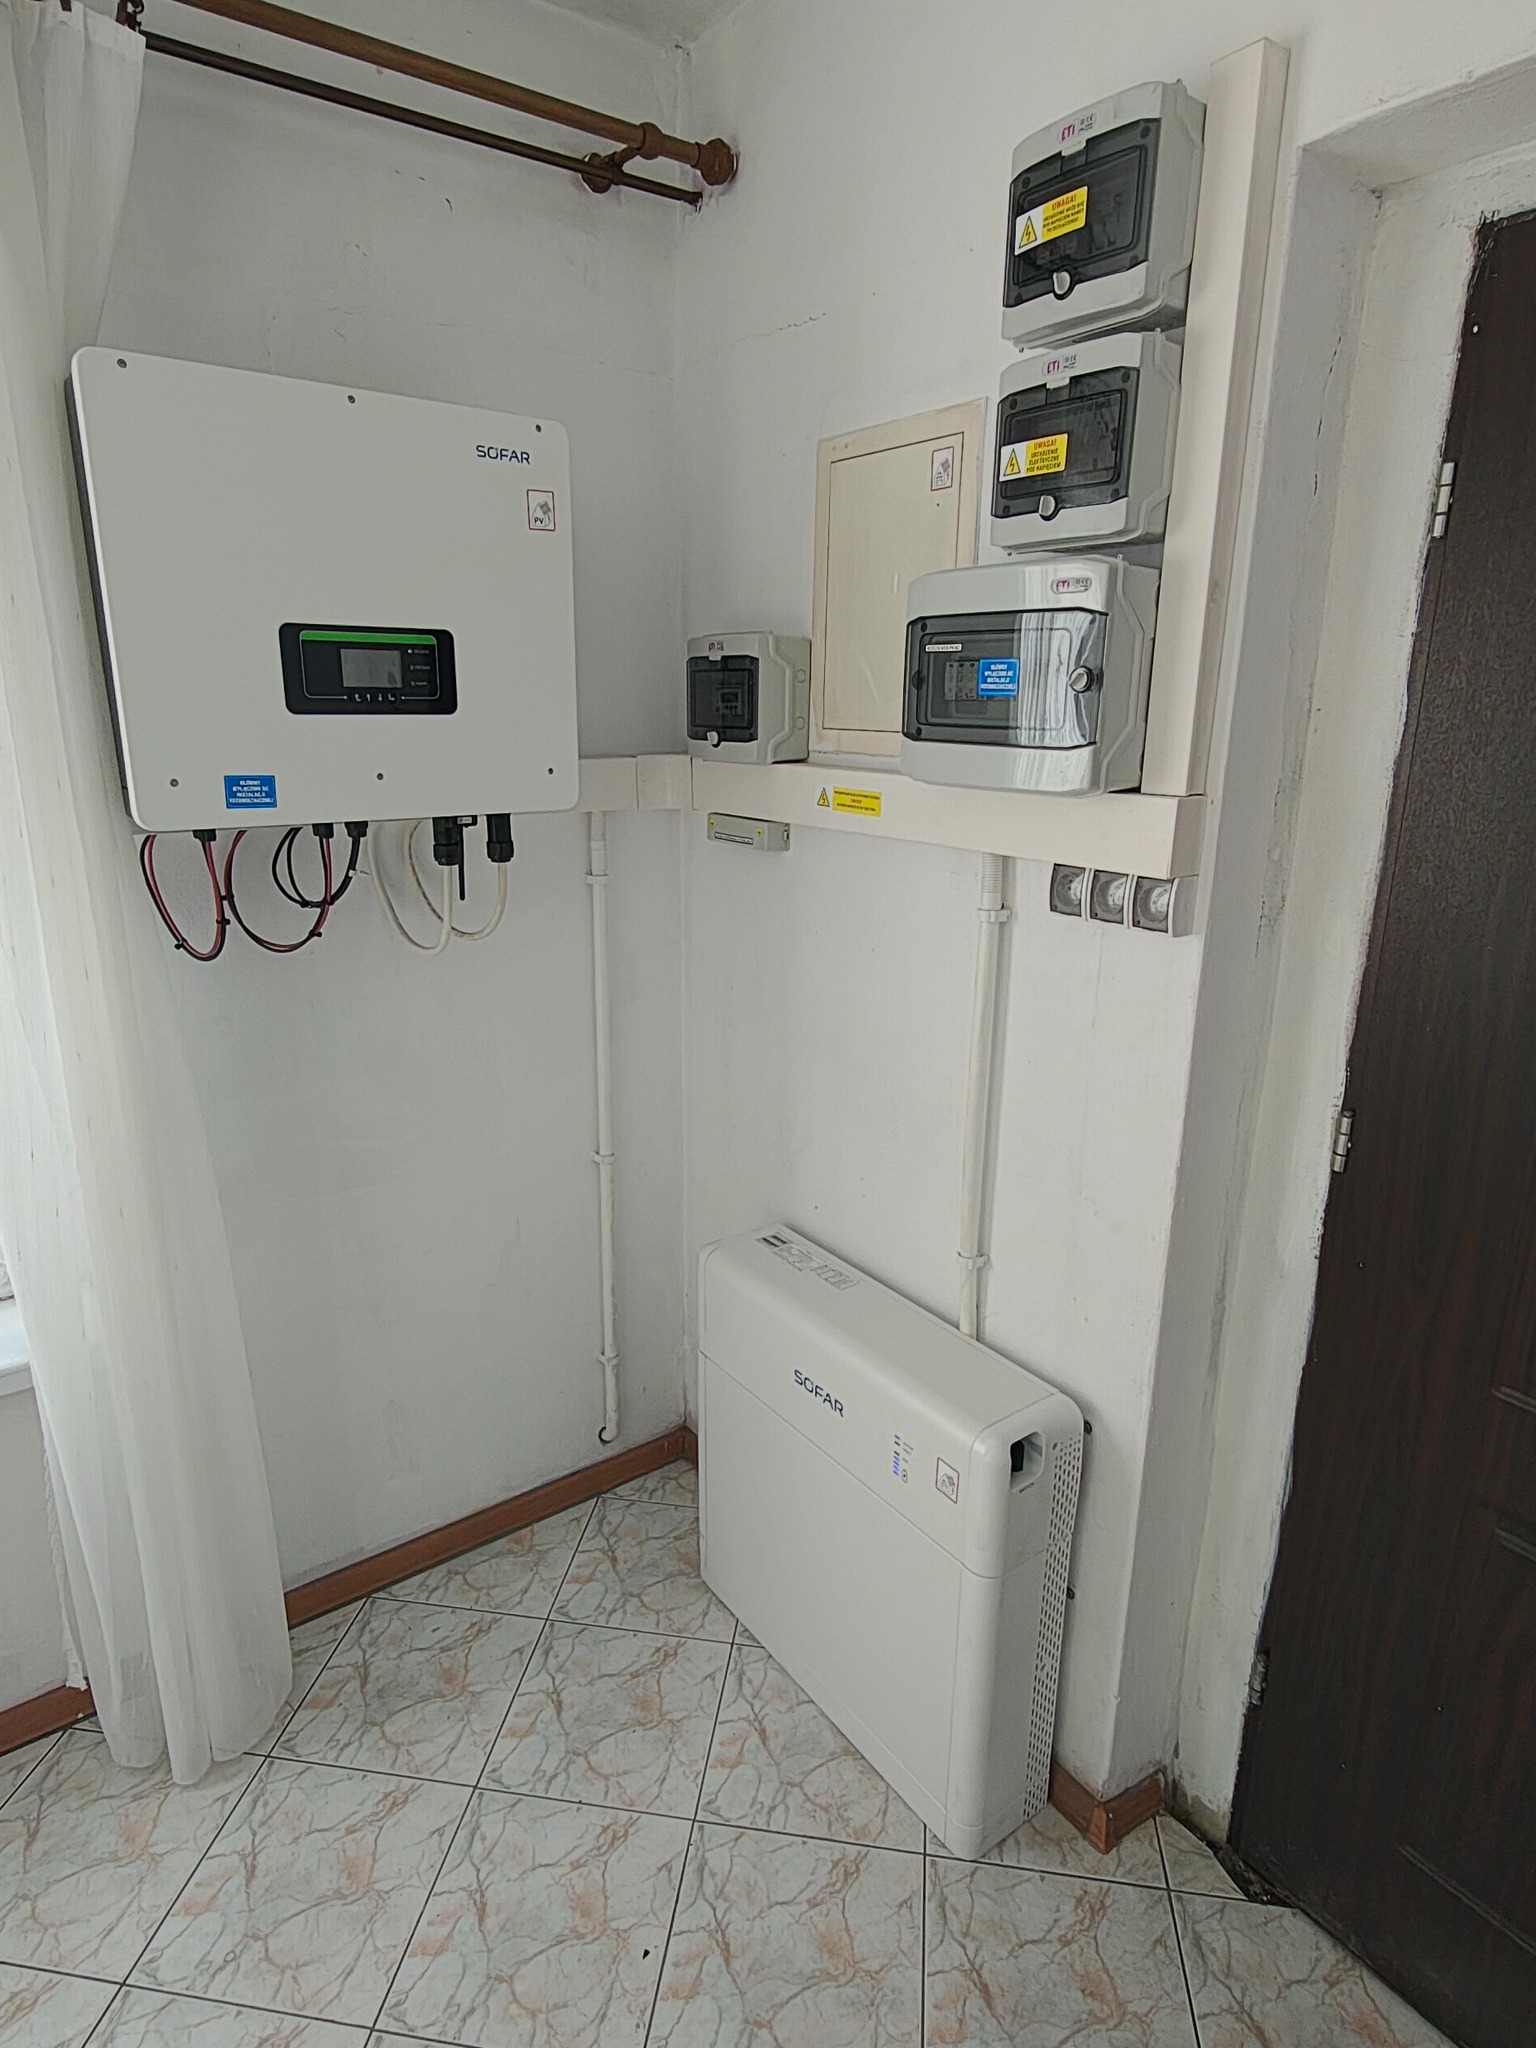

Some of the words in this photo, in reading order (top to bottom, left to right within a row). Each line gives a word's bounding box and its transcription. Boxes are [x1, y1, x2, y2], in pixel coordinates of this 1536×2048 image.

[475, 444, 531, 465] SOFAR
[534, 517, 544, 525] PV
[794, 1369, 844, 1418] SOFAR
